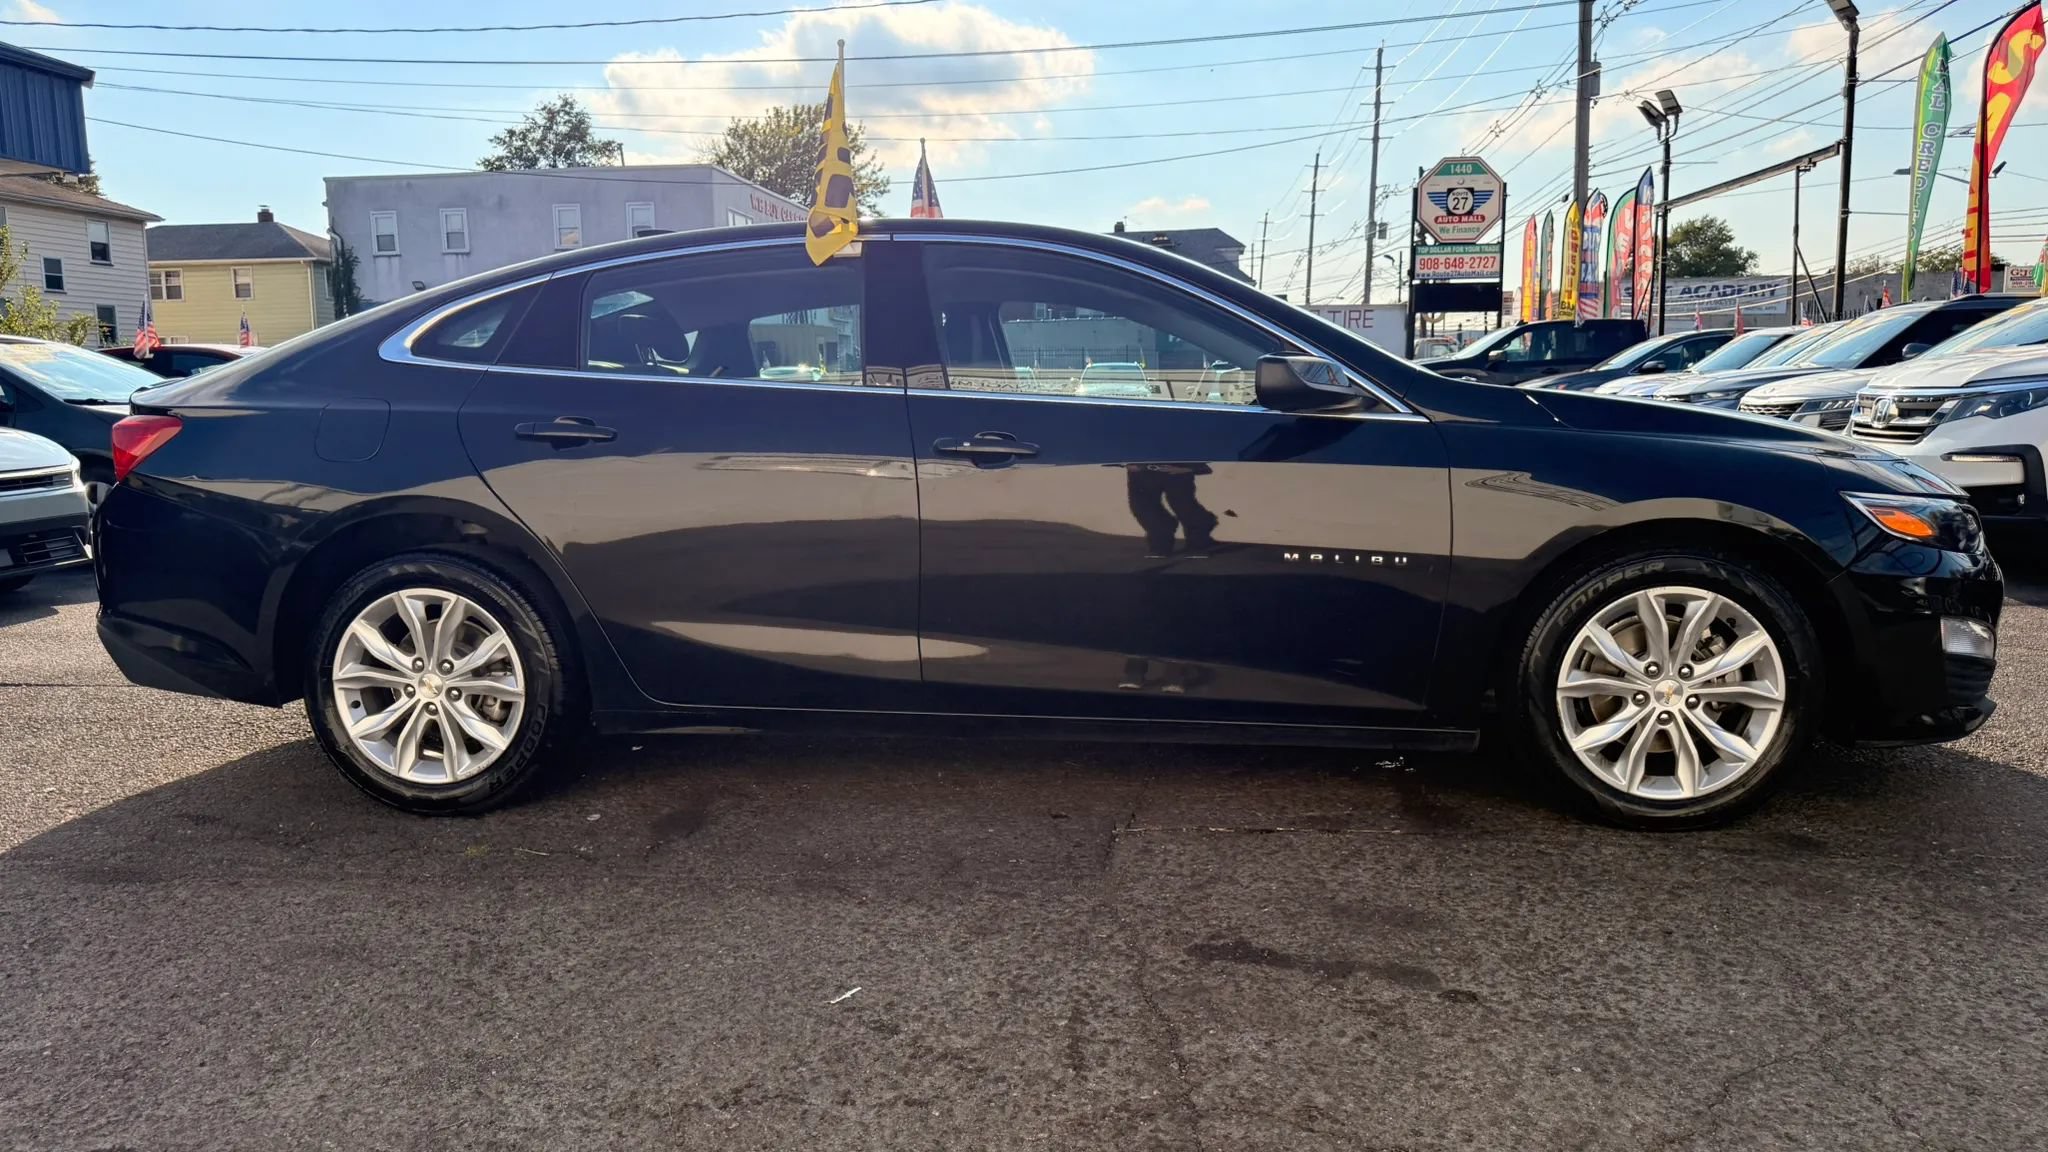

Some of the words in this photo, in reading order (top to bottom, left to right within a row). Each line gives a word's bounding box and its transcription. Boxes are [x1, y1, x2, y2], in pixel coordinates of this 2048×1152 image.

[1450, 163, 1473, 174] 1440
[1452, 197, 1469, 210] 27
[1452, 226, 1481, 234] Finance
[1419, 256, 1497, 270] 908-648-2727
[1327, 309, 1374, 328] TIRE
[1284, 552, 1408, 564] MALIBU
